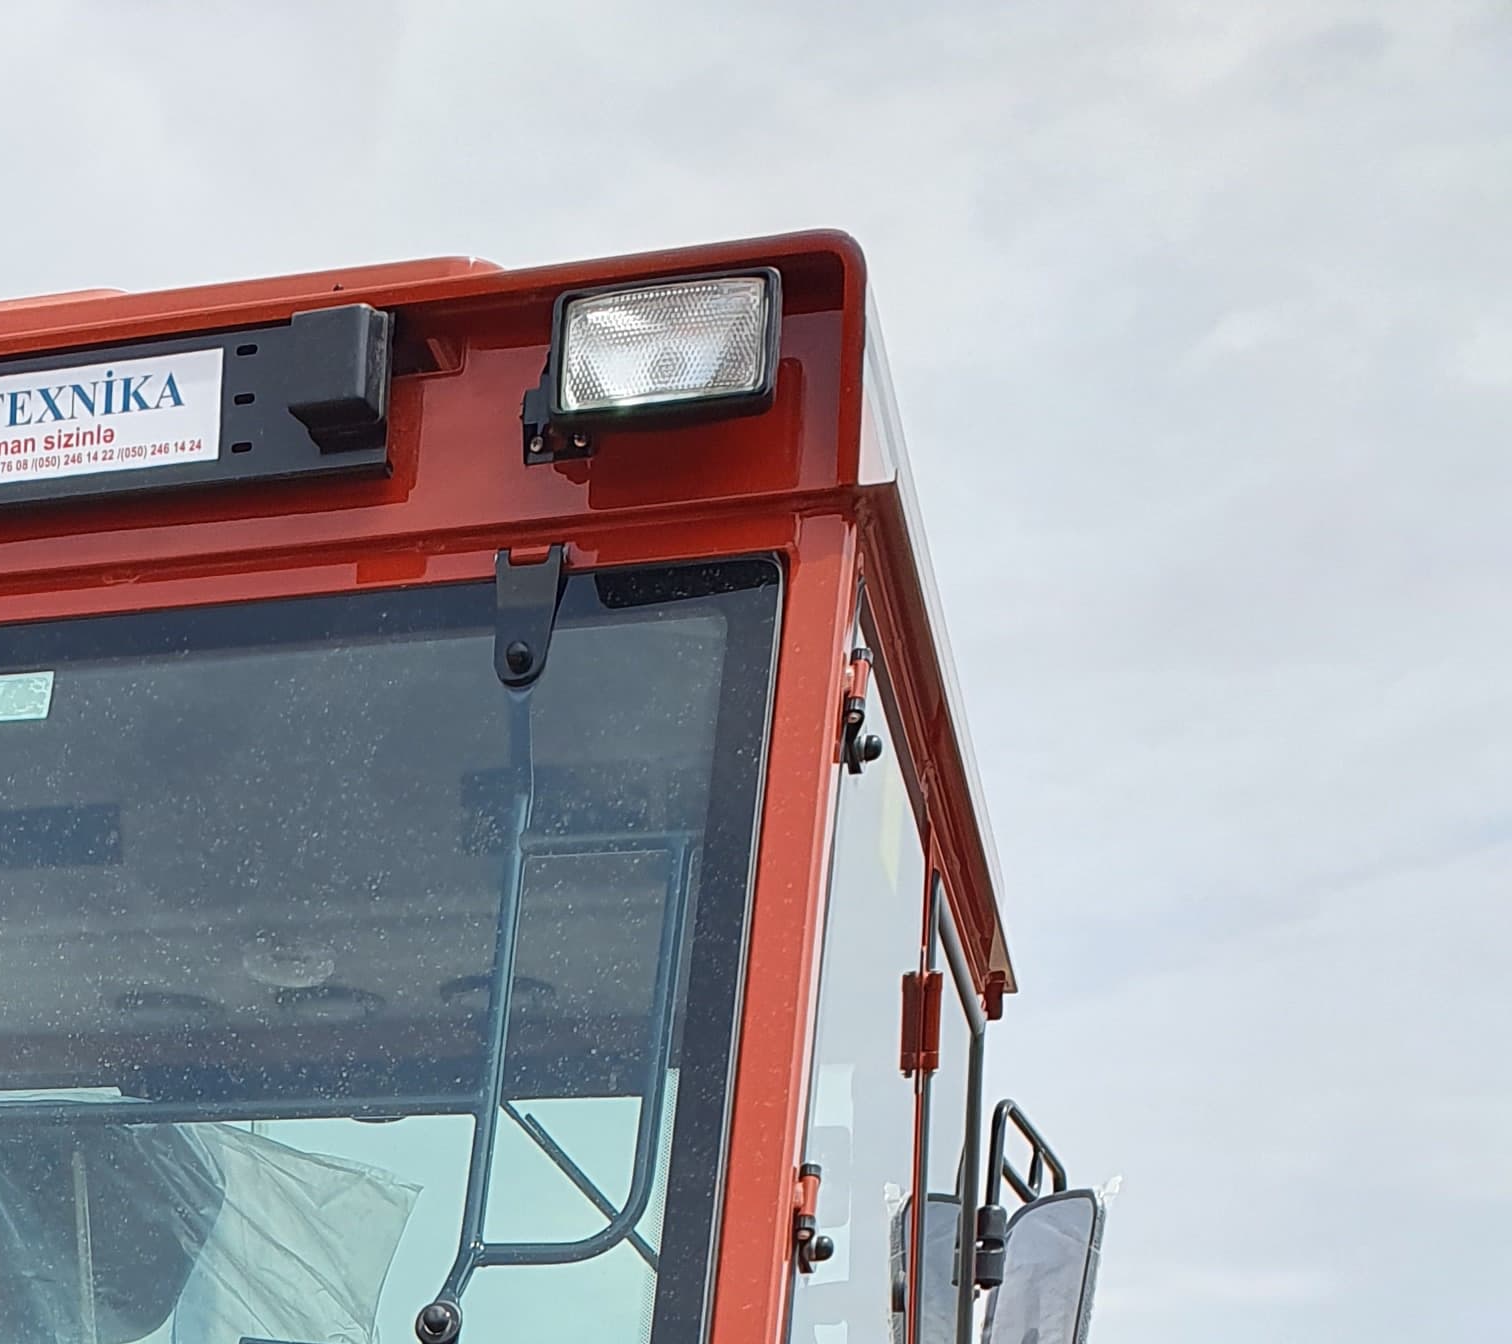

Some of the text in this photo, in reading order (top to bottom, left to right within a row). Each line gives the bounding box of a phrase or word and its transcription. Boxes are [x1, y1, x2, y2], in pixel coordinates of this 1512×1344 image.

[43, 424, 115, 452] sizinlə
[1, 460, 13, 473] 76
[16, 459, 29, 472] 08
[64, 452, 83, 466] 246
[87, 450, 99, 463] 14
[101, 448, 115, 461] 22
[150, 443, 170, 457] 246
[174, 440, 186, 453] 14
[188, 439, 202, 452] 24
